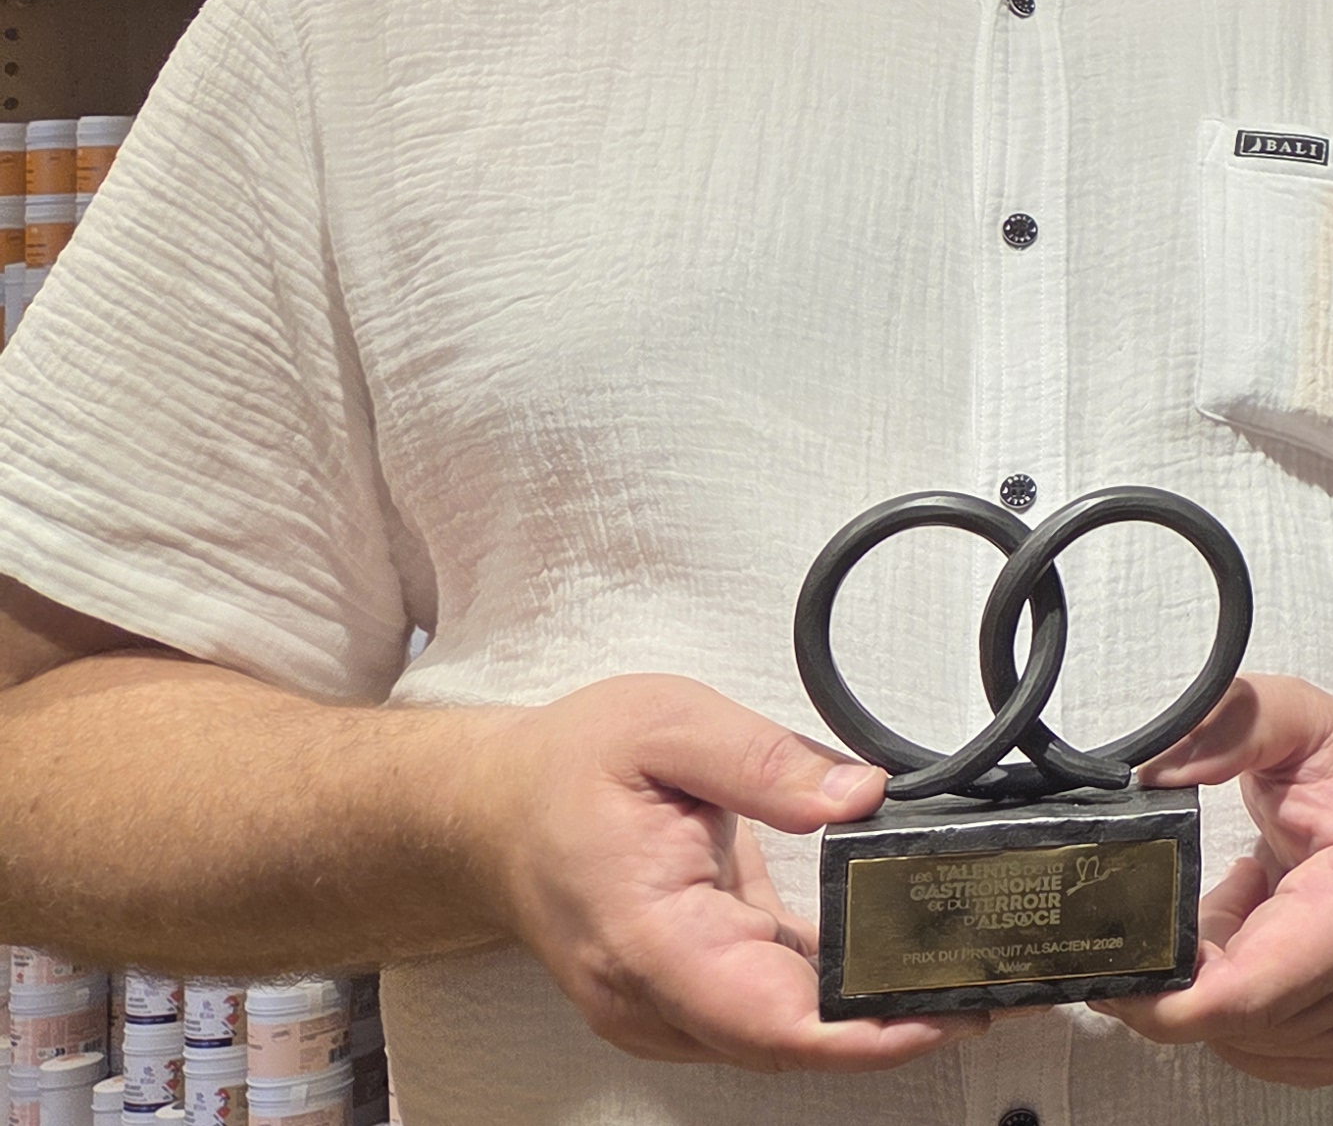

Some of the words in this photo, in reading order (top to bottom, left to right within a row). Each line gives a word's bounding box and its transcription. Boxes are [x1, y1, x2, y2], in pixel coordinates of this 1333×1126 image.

[1266, 140, 1317, 156] BALI
[936, 862, 1019, 880] TALENTS
[910, 876, 1062, 901] GASTRONOMIE
[973, 894, 1061, 913] TERROIR
[903, 950, 935, 964] PRIX
[939, 948, 960, 961] DU
[963, 944, 1022, 960] PRODUIT
[1025, 940, 1090, 955] ALSACIEN
